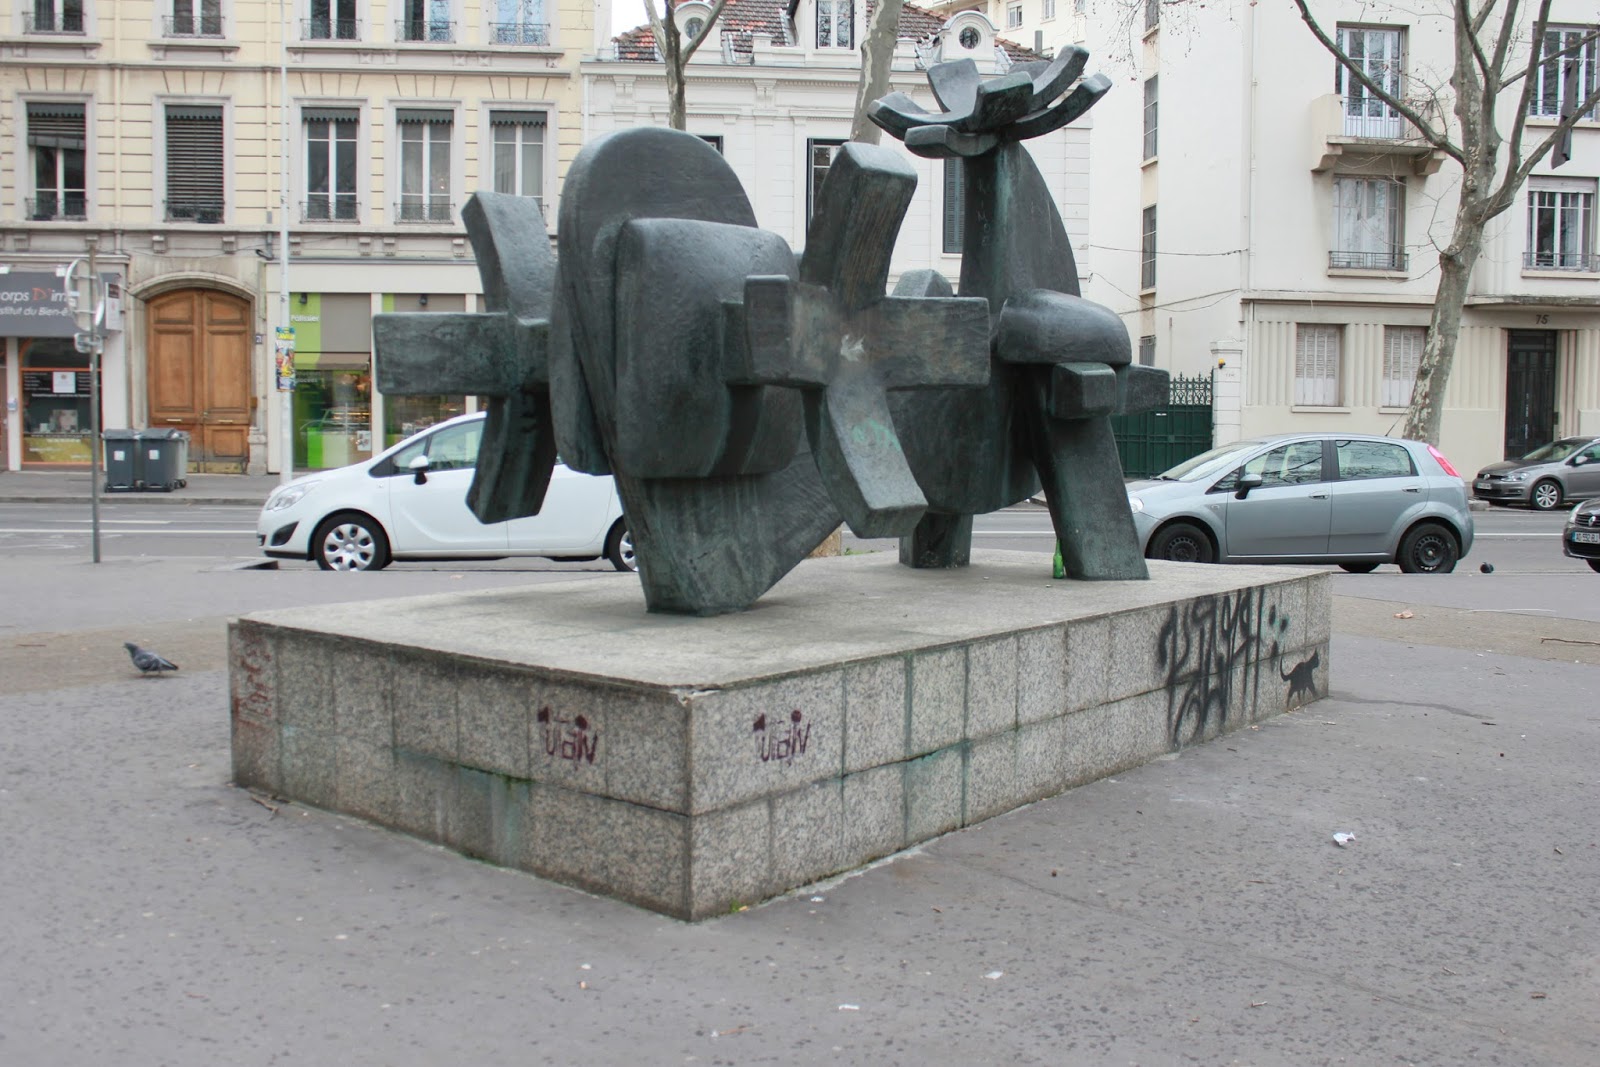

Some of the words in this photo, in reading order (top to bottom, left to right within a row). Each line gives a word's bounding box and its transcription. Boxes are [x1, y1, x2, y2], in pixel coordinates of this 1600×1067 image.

[0, 291, 30, 304] orps
[24, 306, 38, 315] du
[1535, 314, 1550, 325] 75
